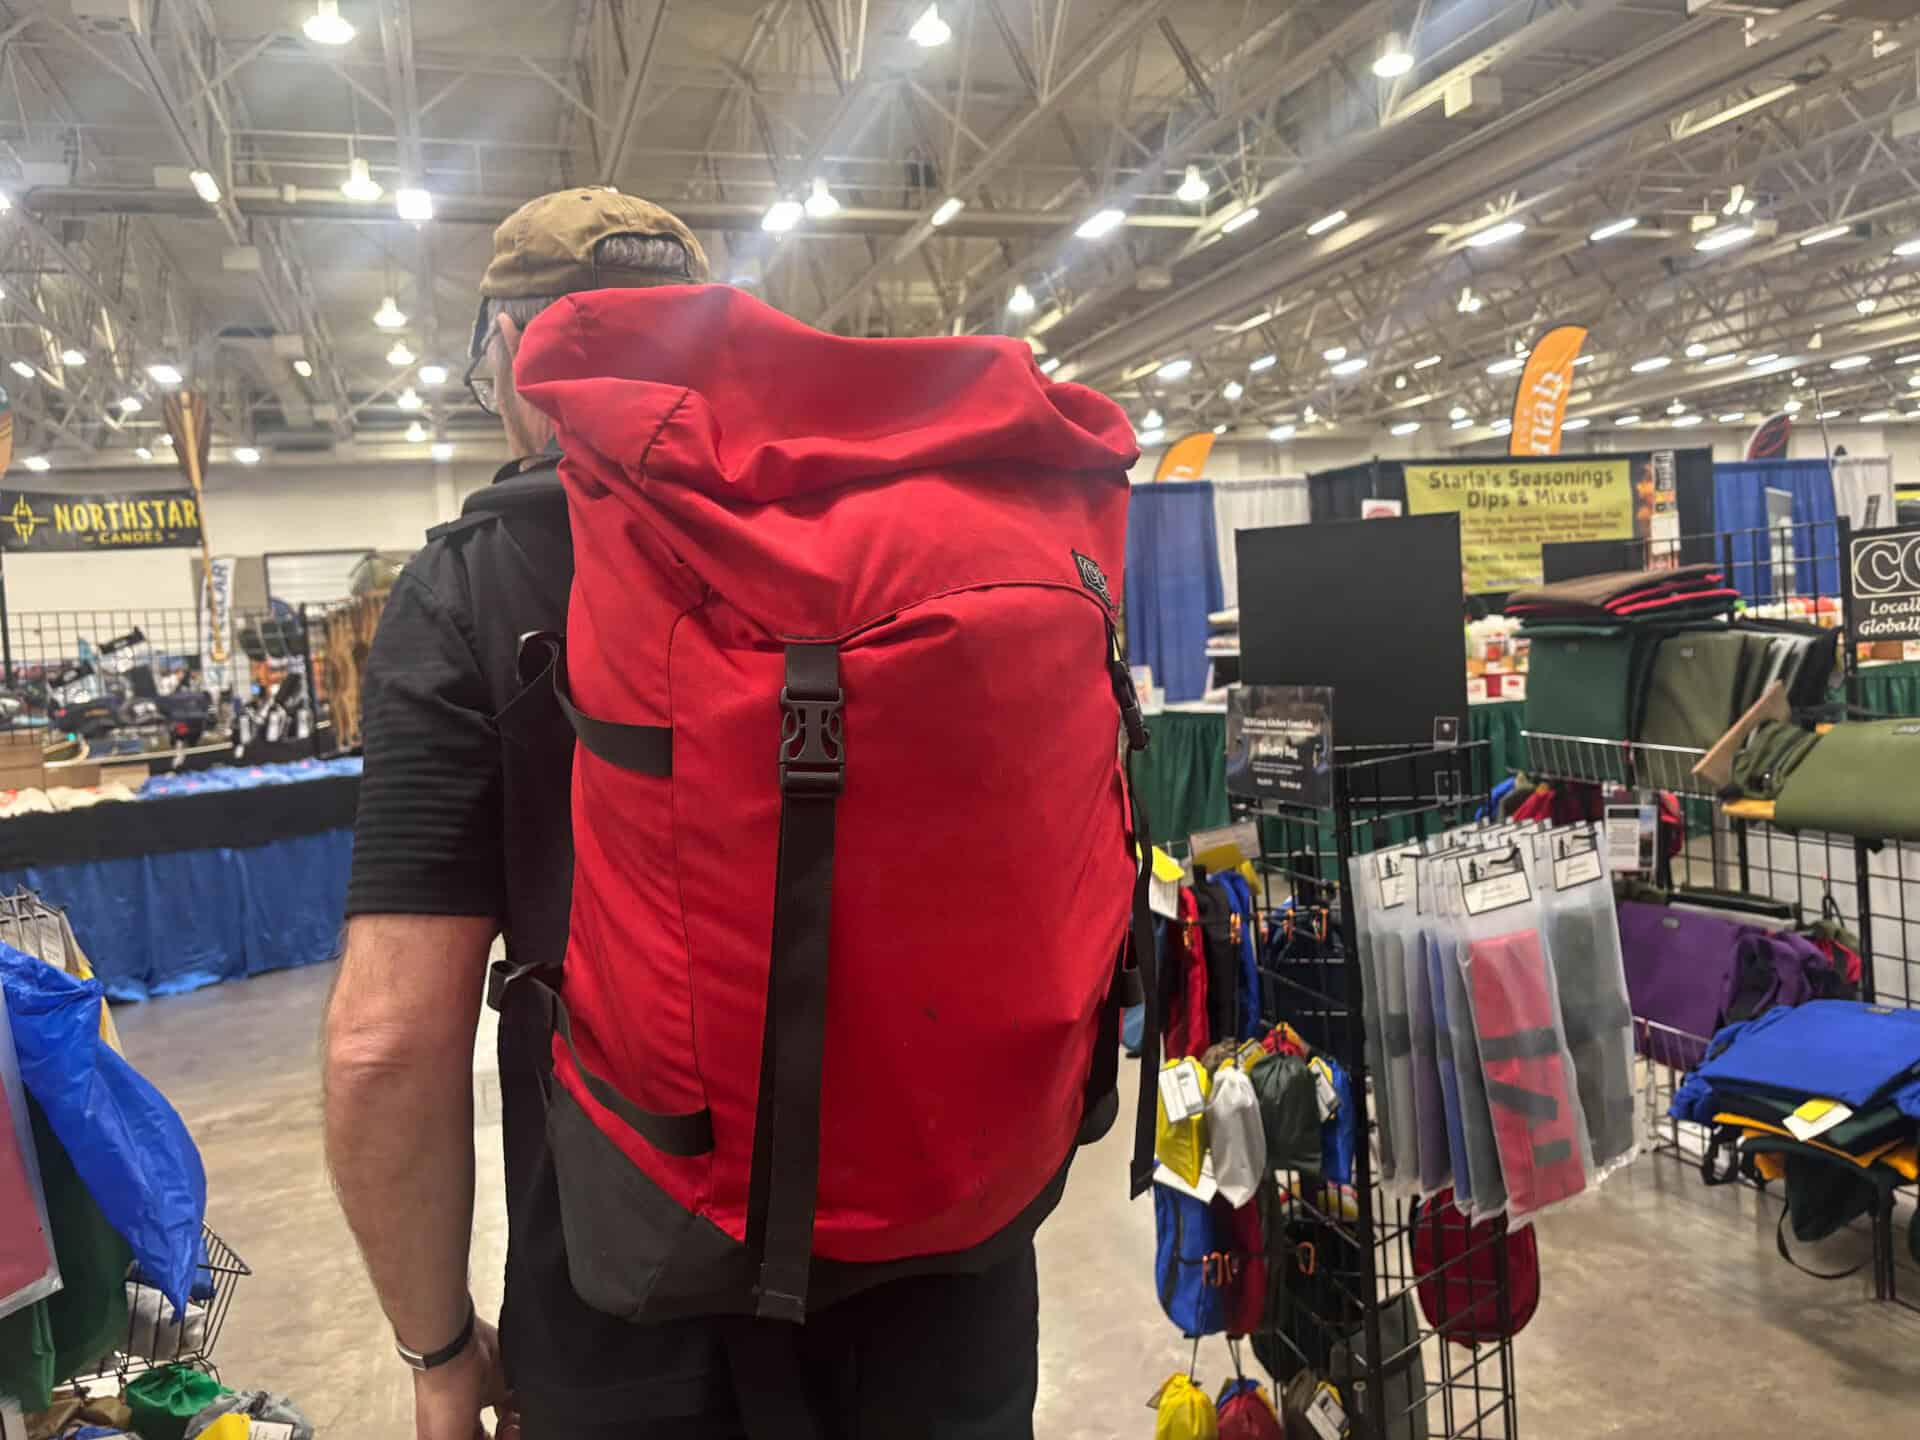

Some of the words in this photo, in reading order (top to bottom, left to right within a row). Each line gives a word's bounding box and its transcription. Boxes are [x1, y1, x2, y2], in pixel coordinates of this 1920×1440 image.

[1508, 467, 1614, 488] Seasonings
[1466, 489, 1511, 511] Dips
[1534, 488, 1589, 506] Mixes
[53, 499, 198, 533] NORTHSTAR
[100, 530, 163, 544] CANOES
[1870, 597, 1920, 615] Locall
[1858, 615, 1920, 636] Globall
